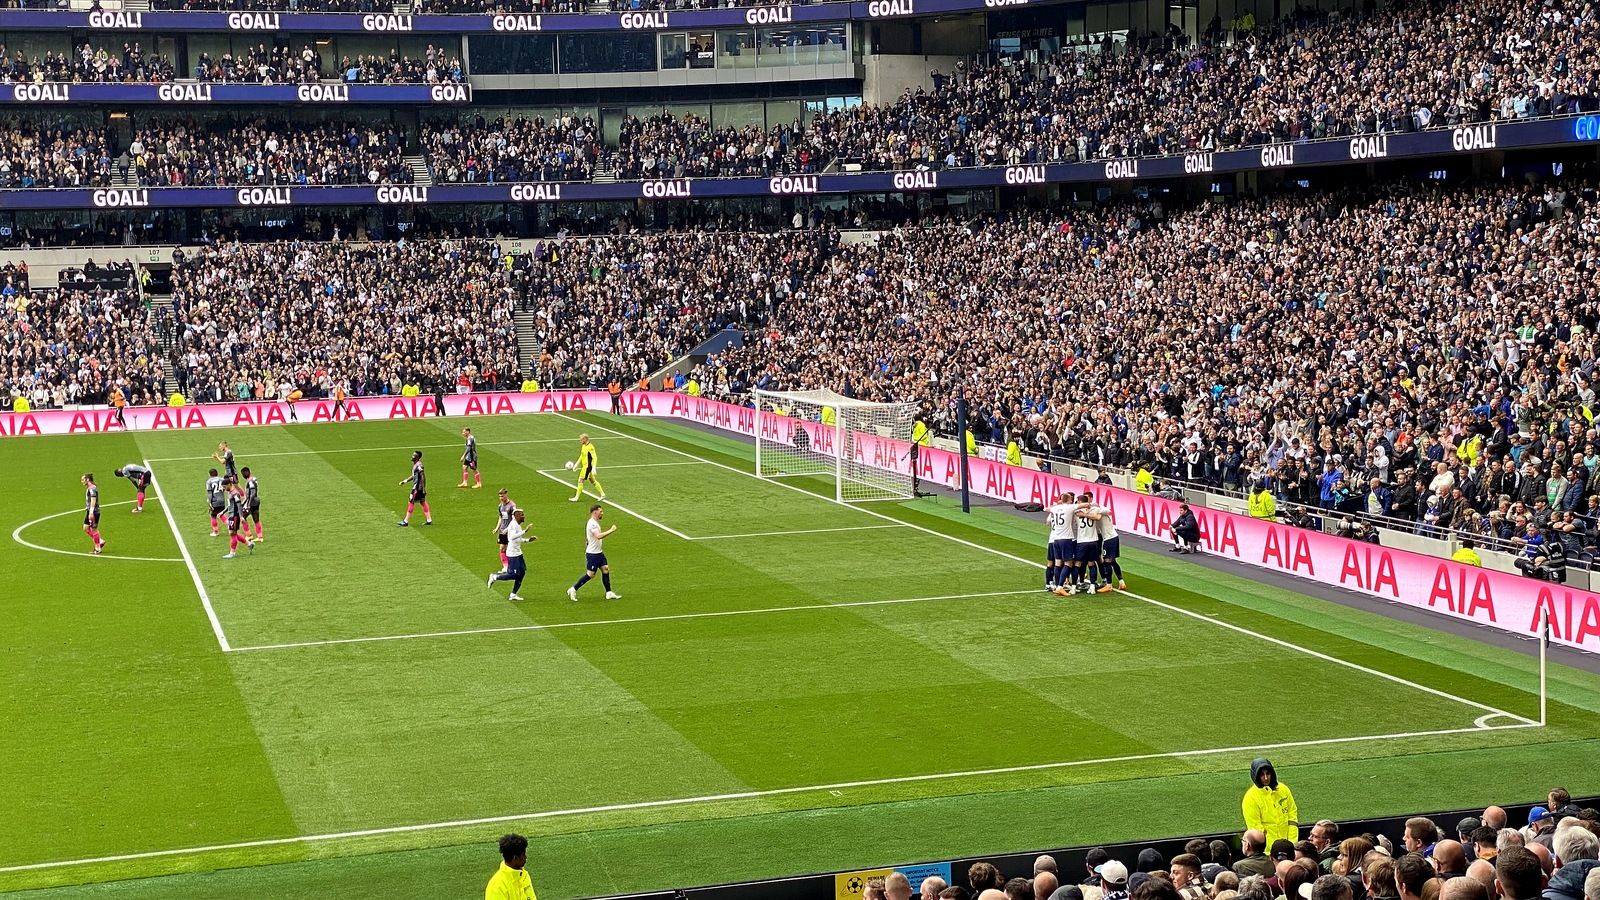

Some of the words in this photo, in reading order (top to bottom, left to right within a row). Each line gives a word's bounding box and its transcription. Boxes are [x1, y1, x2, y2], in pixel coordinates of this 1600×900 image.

[746, 7, 792, 24] GOAL!
[869, 0, 913, 17] GOAL!
[89, 11, 142, 28] GOAL!
[228, 13, 280, 30] GOAL!
[363, 15, 412, 31] GOAL!
[493, 15, 542, 31] GOAL!
[620, 12, 668, 29] GOAL!
[14, 84, 69, 101] GOAL!
[159, 84, 211, 101] GOAL!
[298, 85, 349, 101] GOAL!
[1452, 125, 1496, 151] GOAL!
[1576, 116, 1600, 140] GO
[1261, 145, 1294, 167] GOAL!
[1349, 135, 1387, 160] GOAL!
[1105, 160, 1138, 179] GOAL!
[1184, 153, 1213, 174] GOAL!
[769, 176, 817, 194] GOAL!
[893, 171, 937, 189] GOAL!
[1005, 165, 1045, 185] GOAL!
[93, 189, 148, 206] GOAL!
[238, 188, 291, 205] GOAL!
[377, 187, 428, 203] GOAL!
[510, 184, 561, 200] GOAL!
[642, 181, 691, 197] GOAL!
[312, 401, 364, 422] AIA
[389, 398, 438, 419] AIA
[464, 395, 515, 415] AIA
[540, 393, 587, 412] AIA
[670, 394, 690, 418] AIA
[695, 399, 710, 423] AIA
[69, 411, 123, 433] AIA
[152, 408, 207, 429] AIA
[233, 404, 287, 426] AIA
[715, 402, 732, 429] AIA
[737, 406, 755, 435] AIA
[761, 413, 779, 441] AIA
[813, 424, 834, 454] AIA
[985, 463, 1017, 501] AIA
[1030, 473, 1062, 508] AIA
[1083, 485, 1117, 526] IA
[1055, 513, 1065, 526] 15
[1079, 516, 1095, 529] 30
[1133, 496, 1174, 540] AIA
[1197, 510, 1240, 557] AIA
[1262, 525, 1314, 576] AIA
[1339, 542, 1399, 597] AIA
[1428, 563, 1497, 622] AIA
[1530, 585, 1600, 644] AIA
